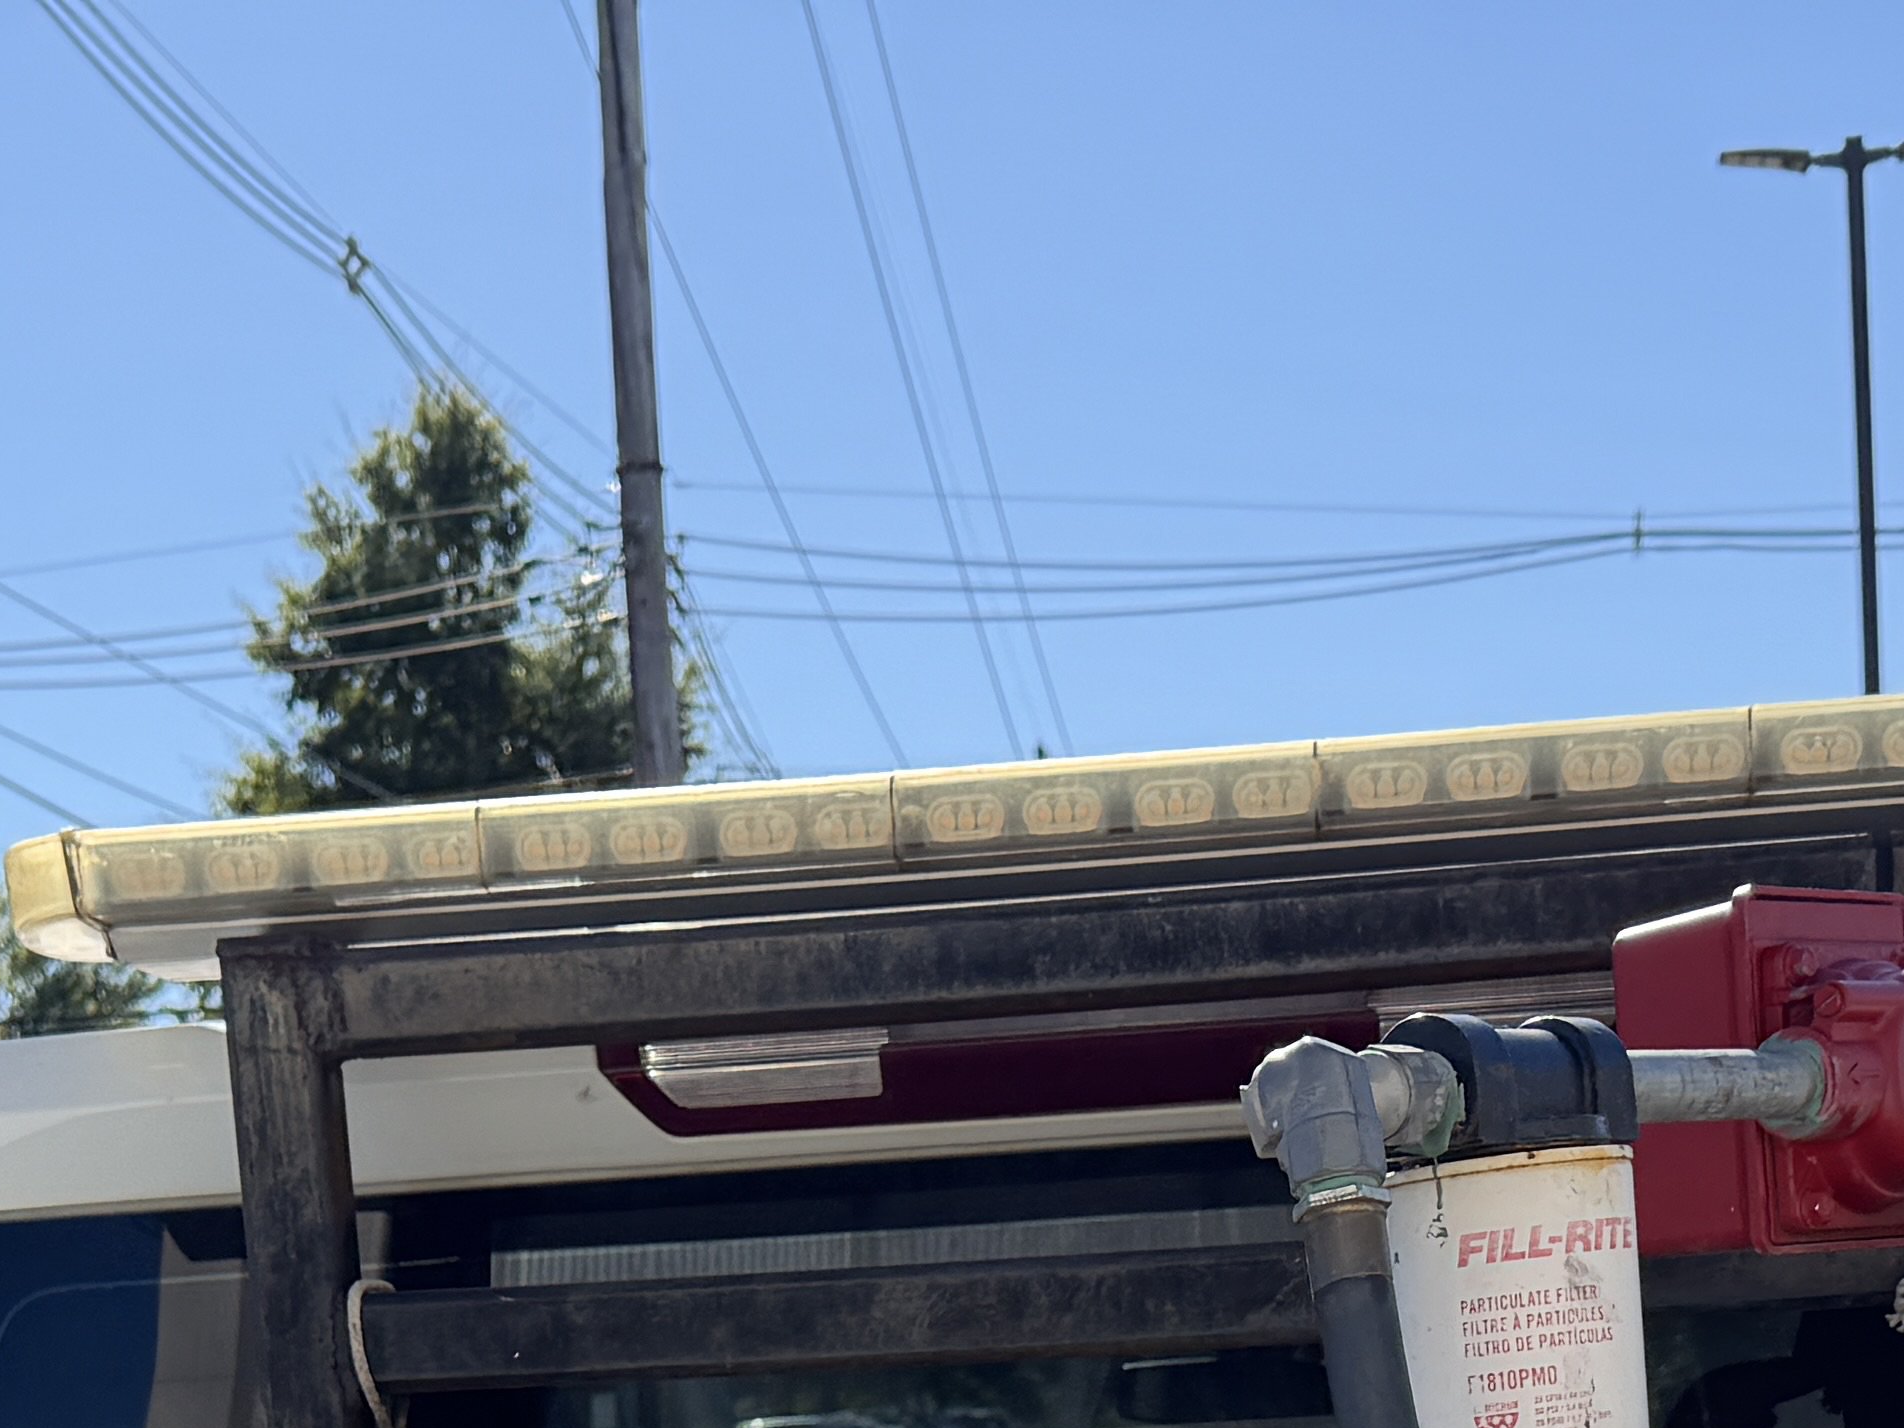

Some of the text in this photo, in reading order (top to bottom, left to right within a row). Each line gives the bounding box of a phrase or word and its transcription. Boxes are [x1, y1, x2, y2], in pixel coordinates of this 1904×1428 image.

[1457, 1216, 1633, 1268] FILL-RITE
[1460, 1284, 1599, 1316] PARTICULATE FILTER
[1462, 1305, 1605, 1338] FILTRE À PARTICULES
[1464, 1326, 1614, 1358] FILTRO DE PARTÍCULAS
